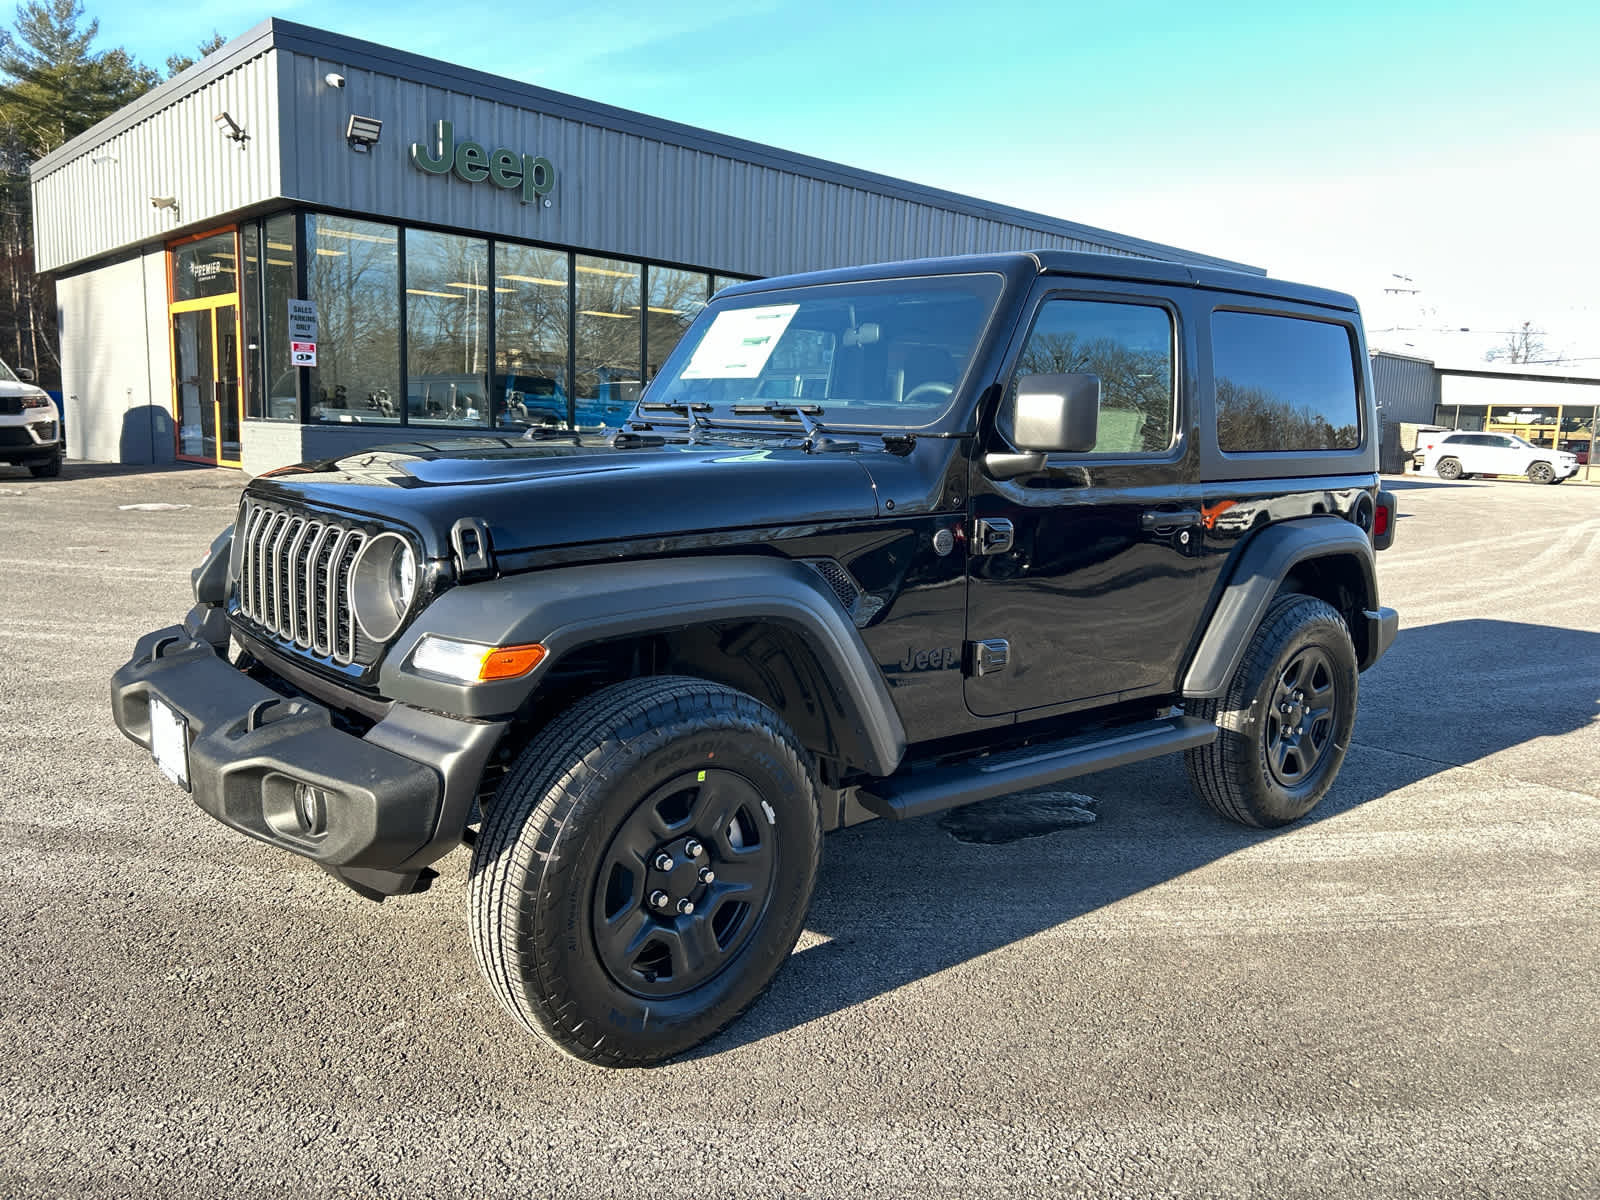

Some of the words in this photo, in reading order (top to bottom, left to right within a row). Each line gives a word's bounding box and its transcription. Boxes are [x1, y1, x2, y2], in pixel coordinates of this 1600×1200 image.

[409, 119, 555, 205] Jeep
[293, 305, 312, 313] SALES
[290, 314, 316, 322] PARKING
[899, 646, 953, 671] Jeep
